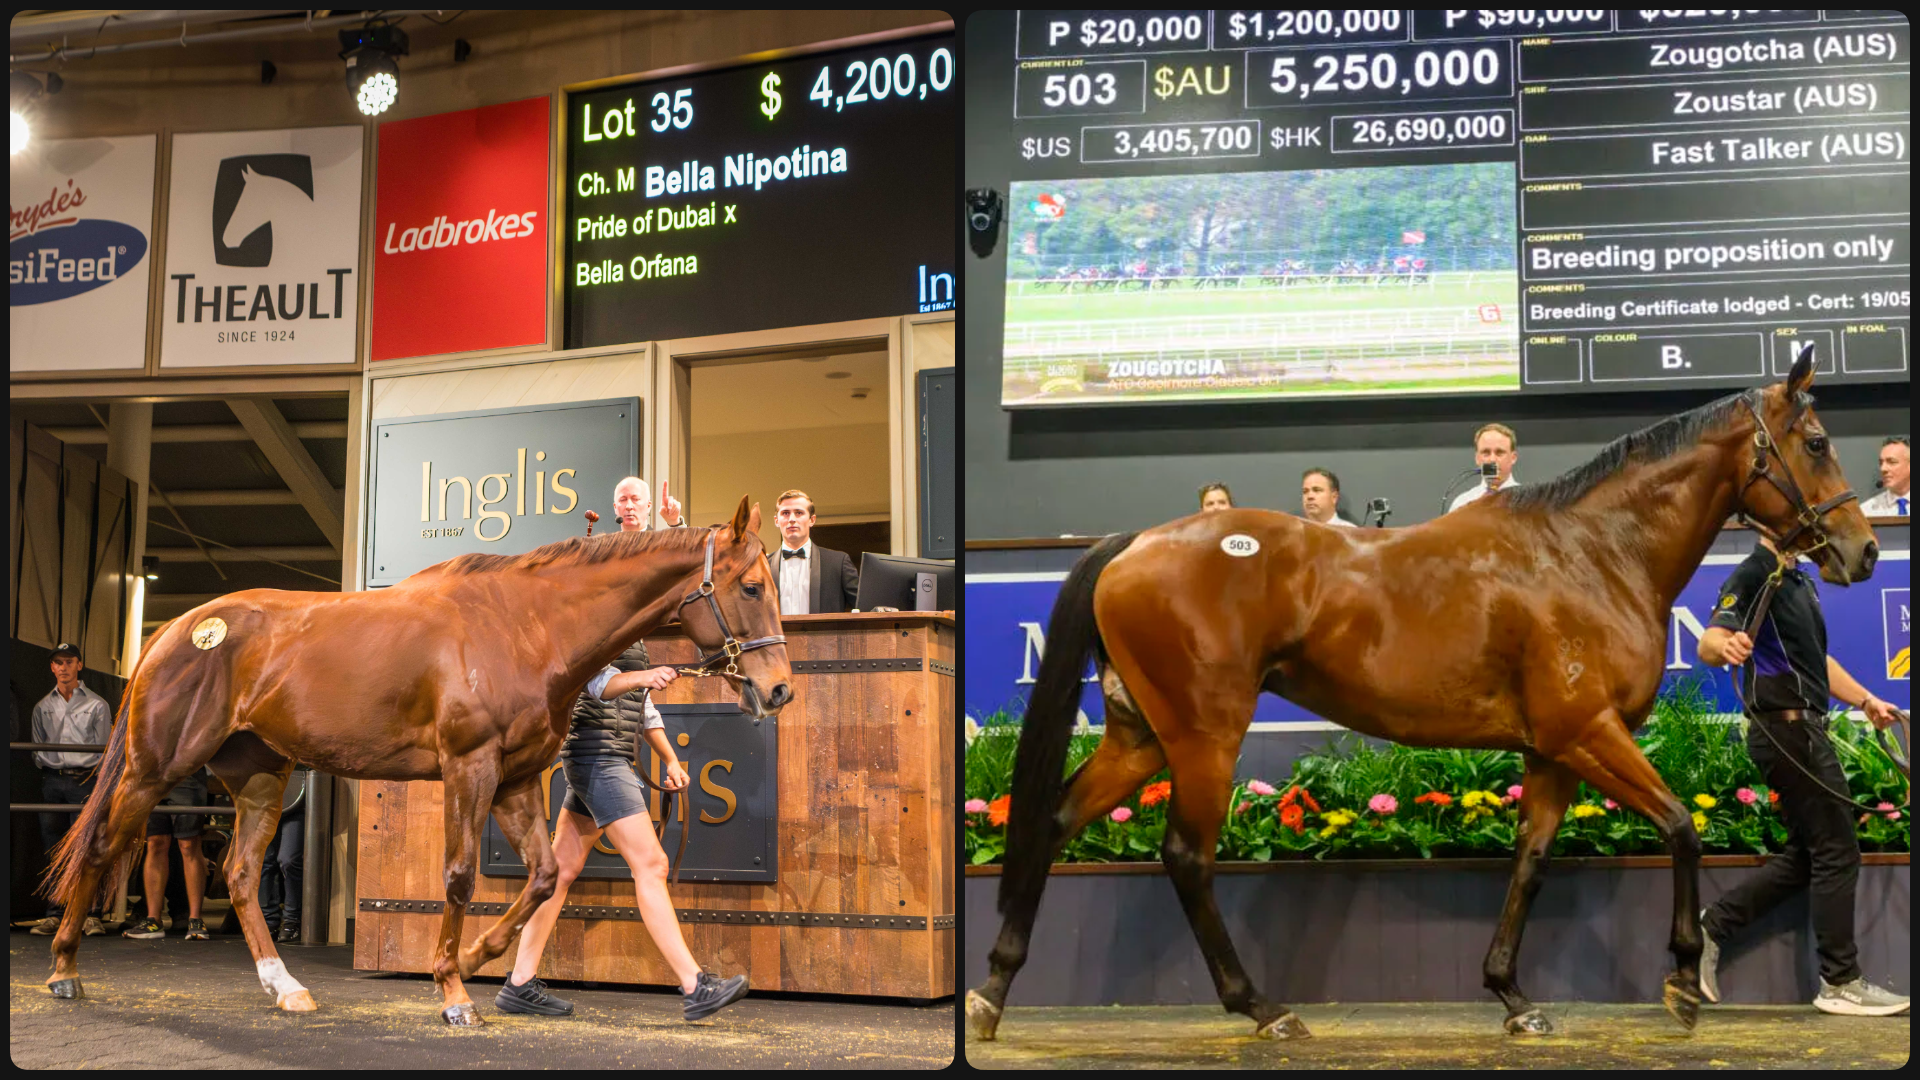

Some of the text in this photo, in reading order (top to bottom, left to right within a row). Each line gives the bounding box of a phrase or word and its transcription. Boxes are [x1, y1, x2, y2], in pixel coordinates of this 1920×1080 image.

[1050, 15, 1201, 47] P $20,000
[1229, 10, 1400, 39] $1,200,000
[1522, 38, 1551, 46] NAME
[1650, 32, 1898, 69] Zougotcha (AUS)
[1154, 65, 1232, 100] $AU
[1271, 48, 1500, 99] 5,250,000
[583, 47, 955, 143] Lot 35 $ 4,200,0
[1043, 72, 1117, 107] 503
[1673, 83, 1878, 115] Zoustar (AUS)
[1113, 124, 1253, 156] 3,405,700
[1270, 127, 1321, 149] $HK
[1352, 114, 1507, 144] 26,690,000
[1022, 136, 1072, 160] $US
[1652, 131, 1906, 165] Fast Talker (AUS)
[577, 145, 847, 198] Ch. M Bella Nipotina
[1526, 182, 1583, 192] COMMENTS
[10, 178, 87, 233] ryde's
[384, 208, 538, 255] Ladbrokes
[577, 202, 737, 242] Pride of Dubai x
[1527, 232, 1584, 242] COMMENTS
[1532, 235, 1894, 272] Breeding proposition only
[576, 253, 698, 287] Bella Orfana
[919, 264, 955, 304] In
[170, 268, 352, 324] THEAULT
[1528, 283, 1586, 293] COMMENTS
[1530, 303, 1616, 321] Breeding
[1621, 299, 1719, 317] Certificate
[1724, 295, 1790, 315] lodged
[1808, 293, 1855, 310] Cert:
[1861, 291, 1910, 308] 19/05
[217, 330, 296, 344] SINCE 1924
[1529, 335, 1567, 345] ONLINE
[1594, 333, 1638, 343] COLOUR
[1776, 327, 1797, 336] SEX
[1846, 323, 1887, 334] IN FOAL
[1107, 360, 1226, 378] ZOUGOTCHA
[1661, 345, 1692, 369] B.
[421, 447, 579, 542] Inglis
[421, 527, 464, 539] EST 1867
[1229, 540, 1251, 551] 503
